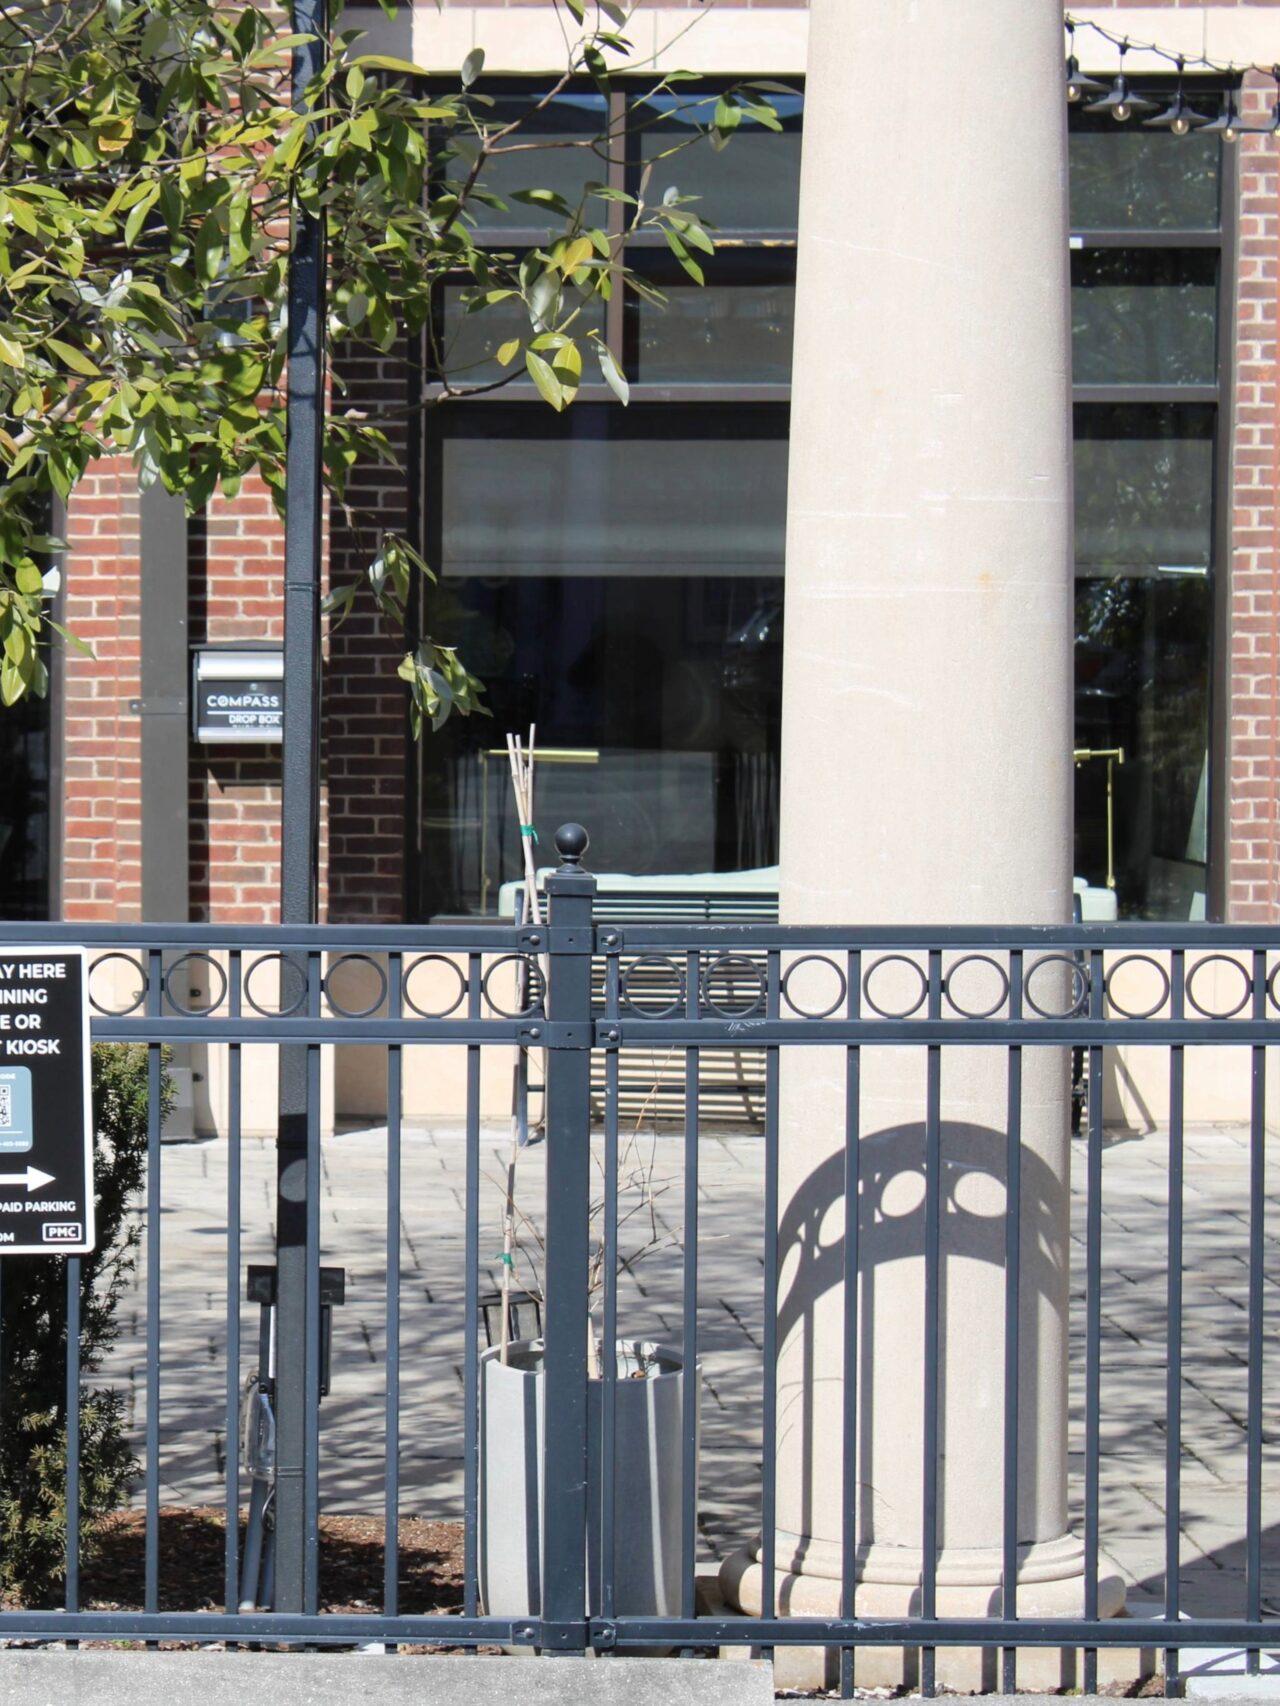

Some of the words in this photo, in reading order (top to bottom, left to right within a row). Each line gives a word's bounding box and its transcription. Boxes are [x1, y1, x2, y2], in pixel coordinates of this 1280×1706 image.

[206, 695, 279, 708] COMPASS
[228, 714, 257, 724] DROP
[258, 714, 281, 724] BOX
[19, 963, 67, 979] HERE
[14, 1014, 41, 1030] OR
[6, 1038, 61, 1055] KIOSK
[24, 1200, 76, 1213] PARKING
[48, 1226, 76, 1238] PMC
